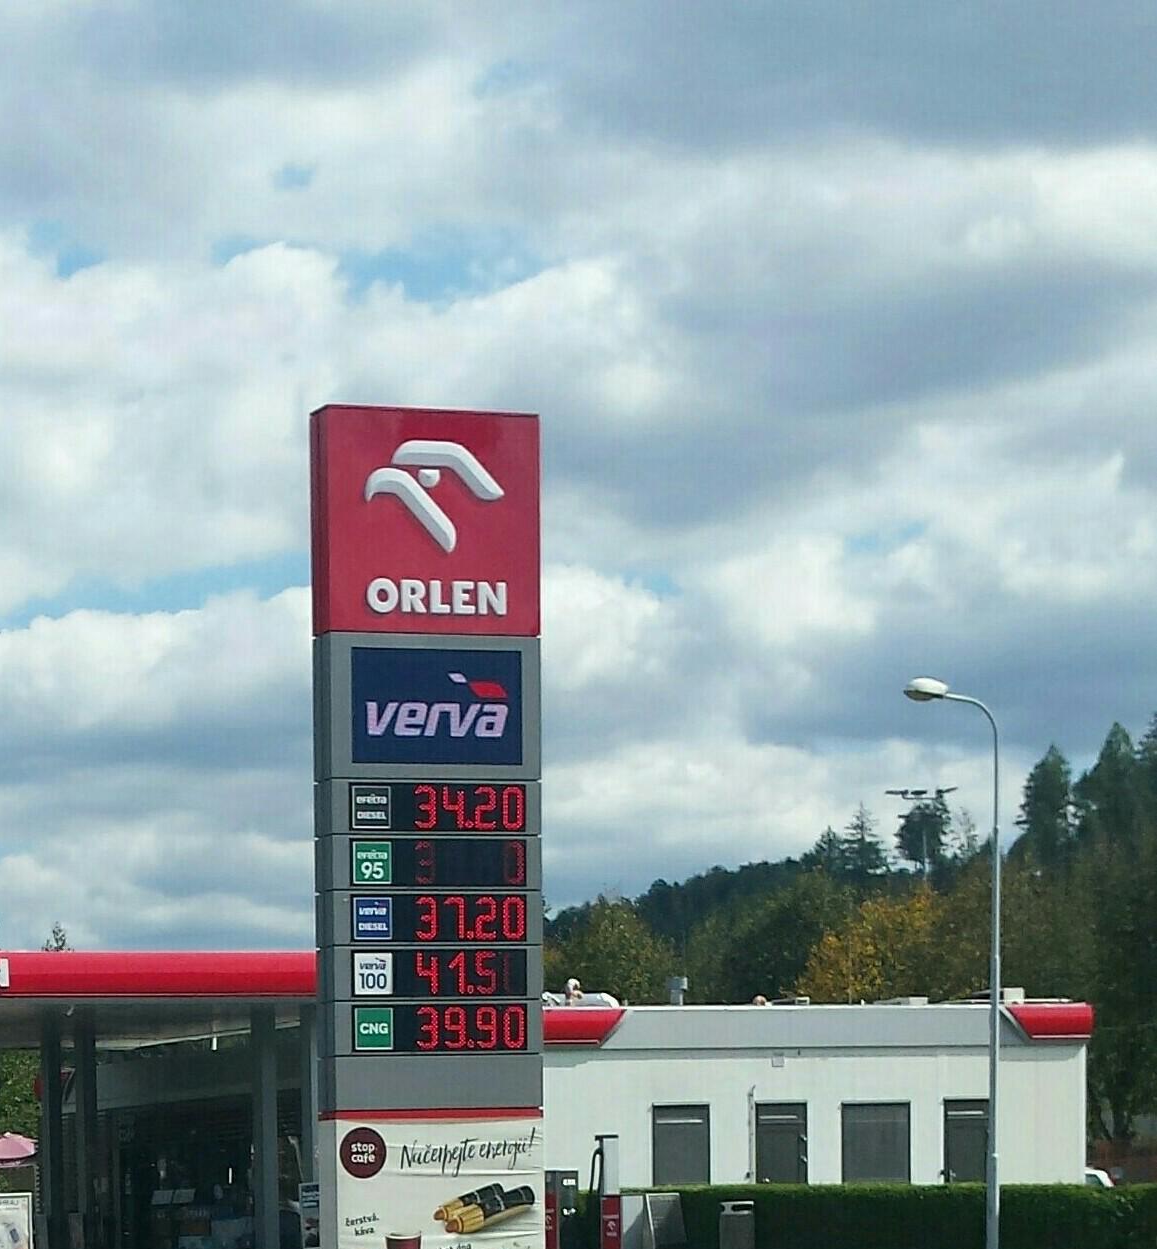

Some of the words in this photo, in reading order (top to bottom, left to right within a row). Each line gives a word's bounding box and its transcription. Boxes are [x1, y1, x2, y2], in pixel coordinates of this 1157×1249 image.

[366, 577, 507, 616] ORLEN
[364, 700, 509, 737] verva
[413, 784, 524, 829] 34.20
[356, 811, 387, 820] DIESEL
[360, 861, 384, 879] 95
[414, 895, 525, 940] 37.20
[358, 922, 388, 931] DIESEL
[359, 973, 387, 989] 100
[359, 1022, 389, 1035] CNG
[415, 1005, 525, 1049] 39.90
[351, 1142, 375, 1154] stop
[351, 1153, 375, 1164] cafe
